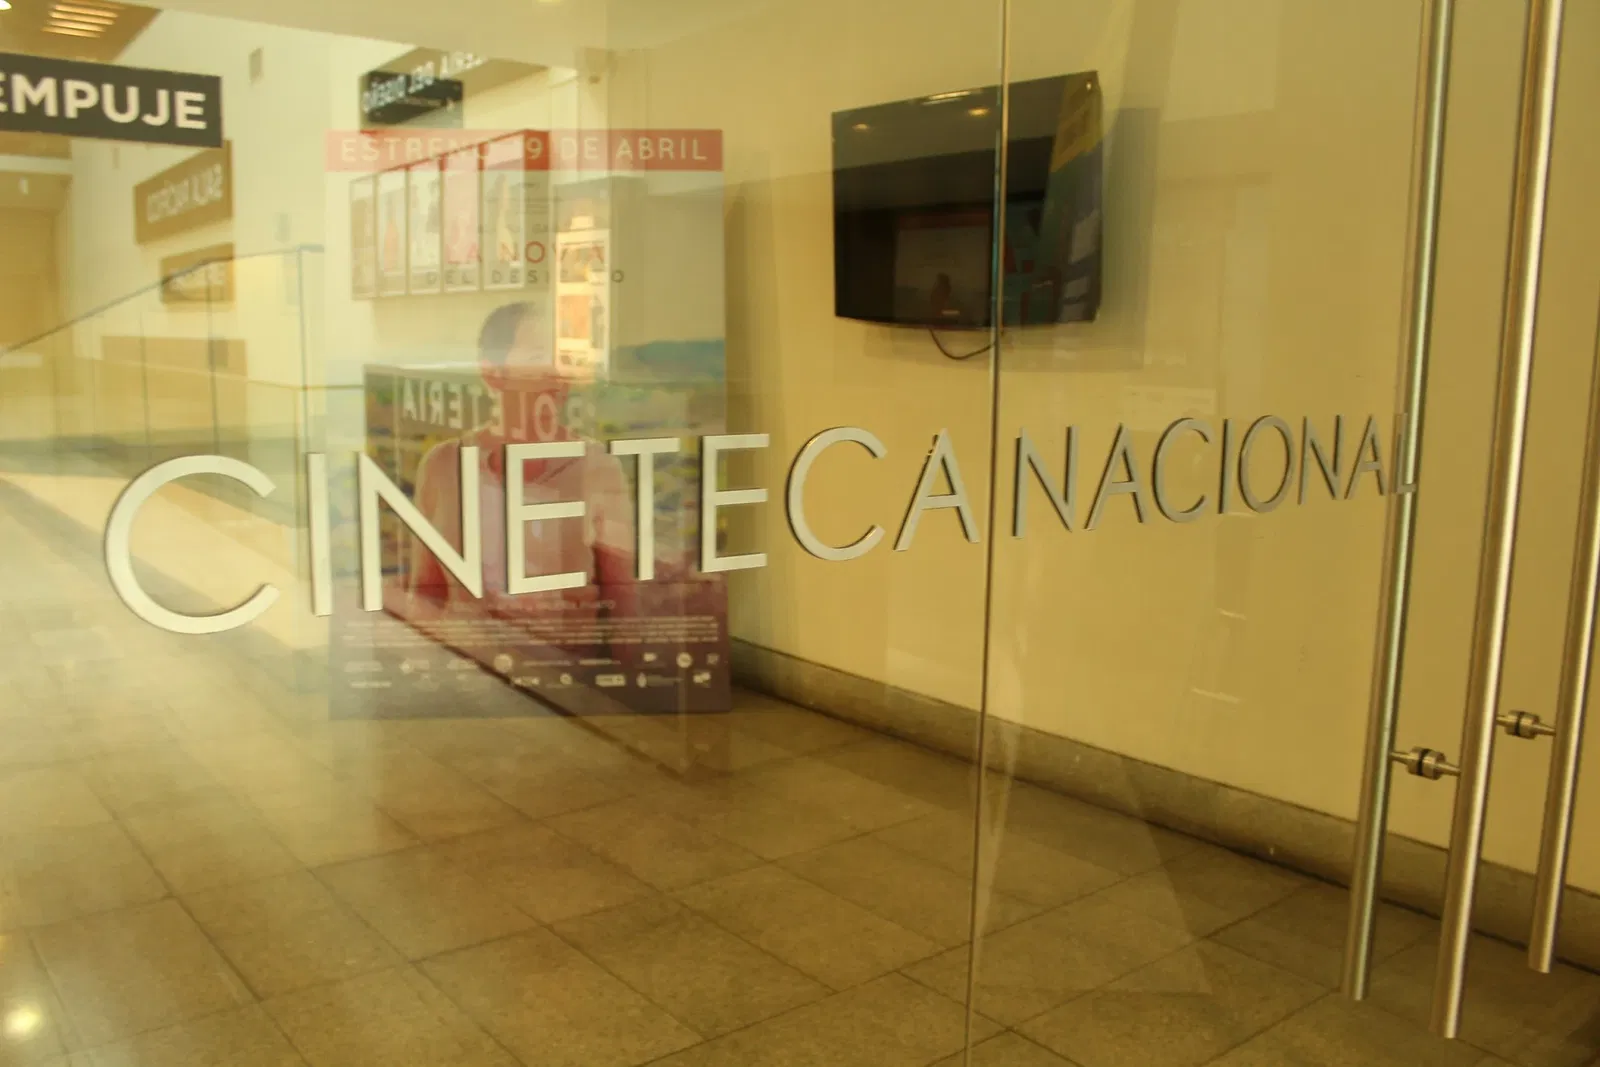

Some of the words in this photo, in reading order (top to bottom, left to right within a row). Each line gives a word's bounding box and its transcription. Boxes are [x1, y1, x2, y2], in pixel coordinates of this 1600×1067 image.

[0, 72, 207, 131] MPUJE
[560, 137, 599, 160] DE
[616, 137, 708, 161] ABRIL
[426, 270, 474, 284] DEL
[104, 426, 980, 635] CINETECA
[1012, 412, 1416, 538] NACIONAL
